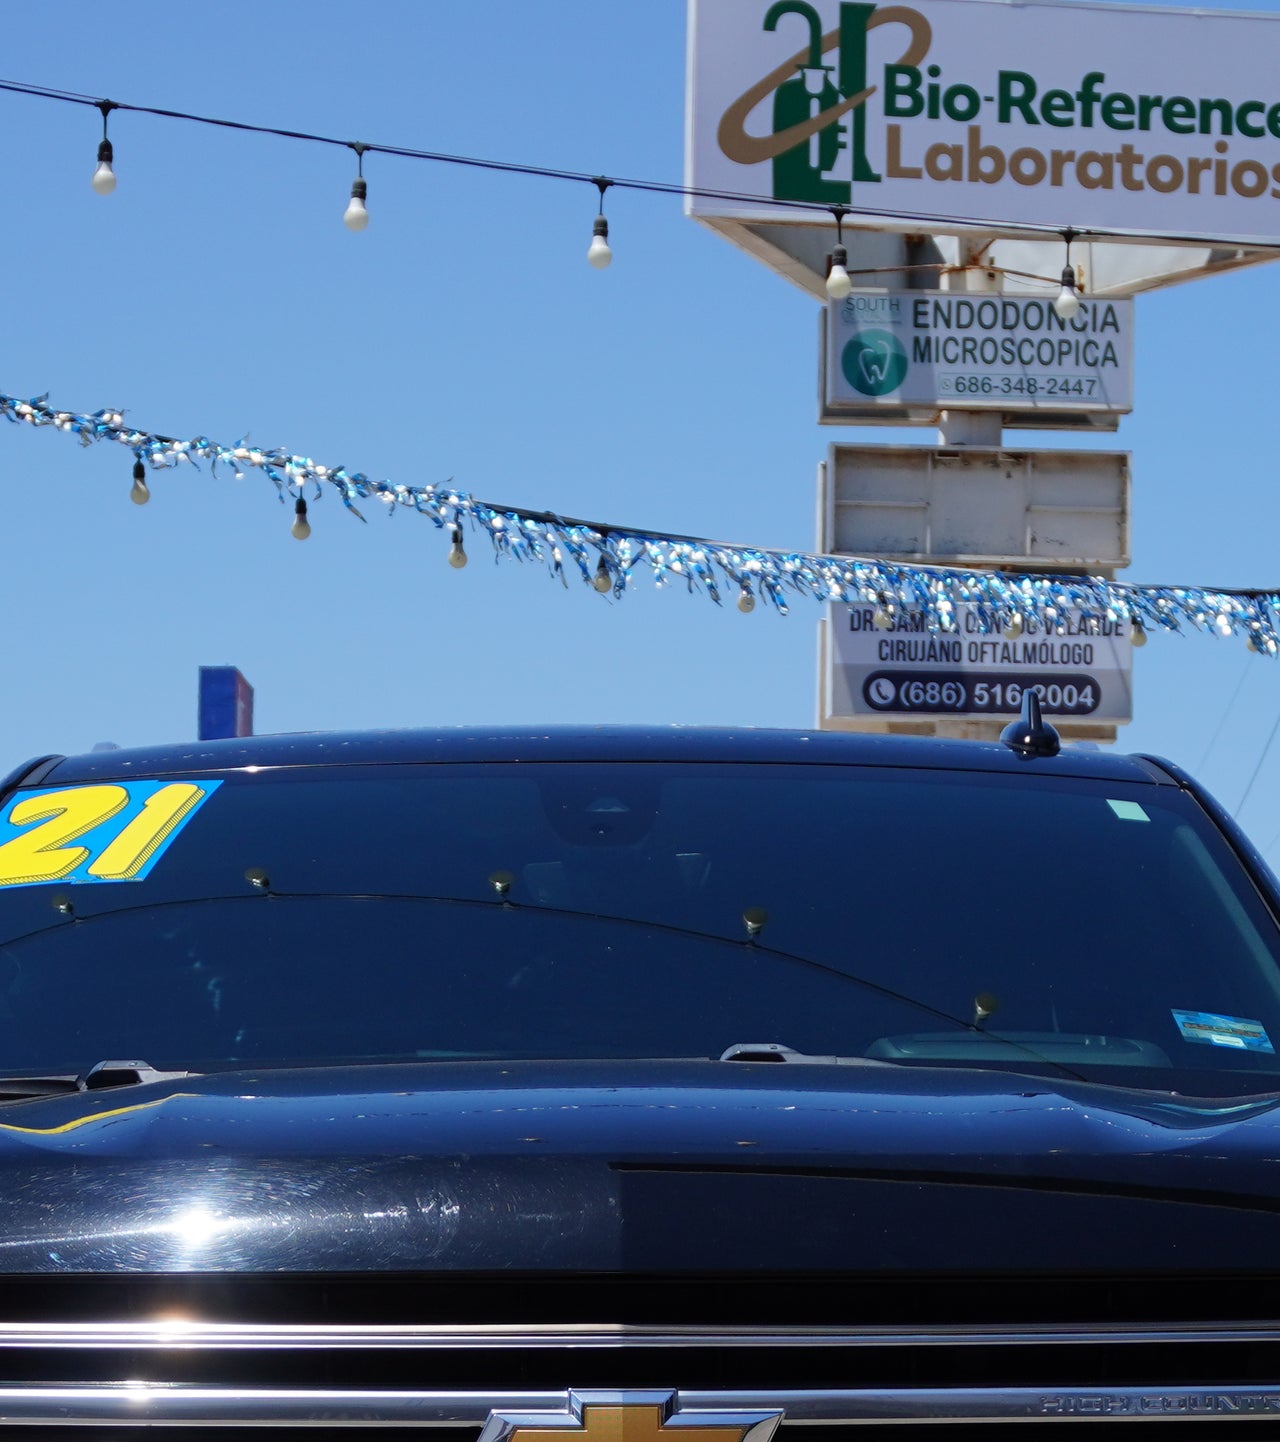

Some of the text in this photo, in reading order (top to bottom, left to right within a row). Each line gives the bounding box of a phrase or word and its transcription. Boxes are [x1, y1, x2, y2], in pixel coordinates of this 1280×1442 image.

[846, 297, 900, 312] SOUTH
[913, 299, 1120, 333] ENDODONCIA
[913, 335, 1119, 368] MICROSCOPICA
[955, 376, 1097, 395] 686-348-2447
[878, 638, 1094, 665] CIRUJANO OFTALMÓLOGO
[899, 681, 967, 707] (686)
[1040, 1396, 1128, 1412] HIGH
